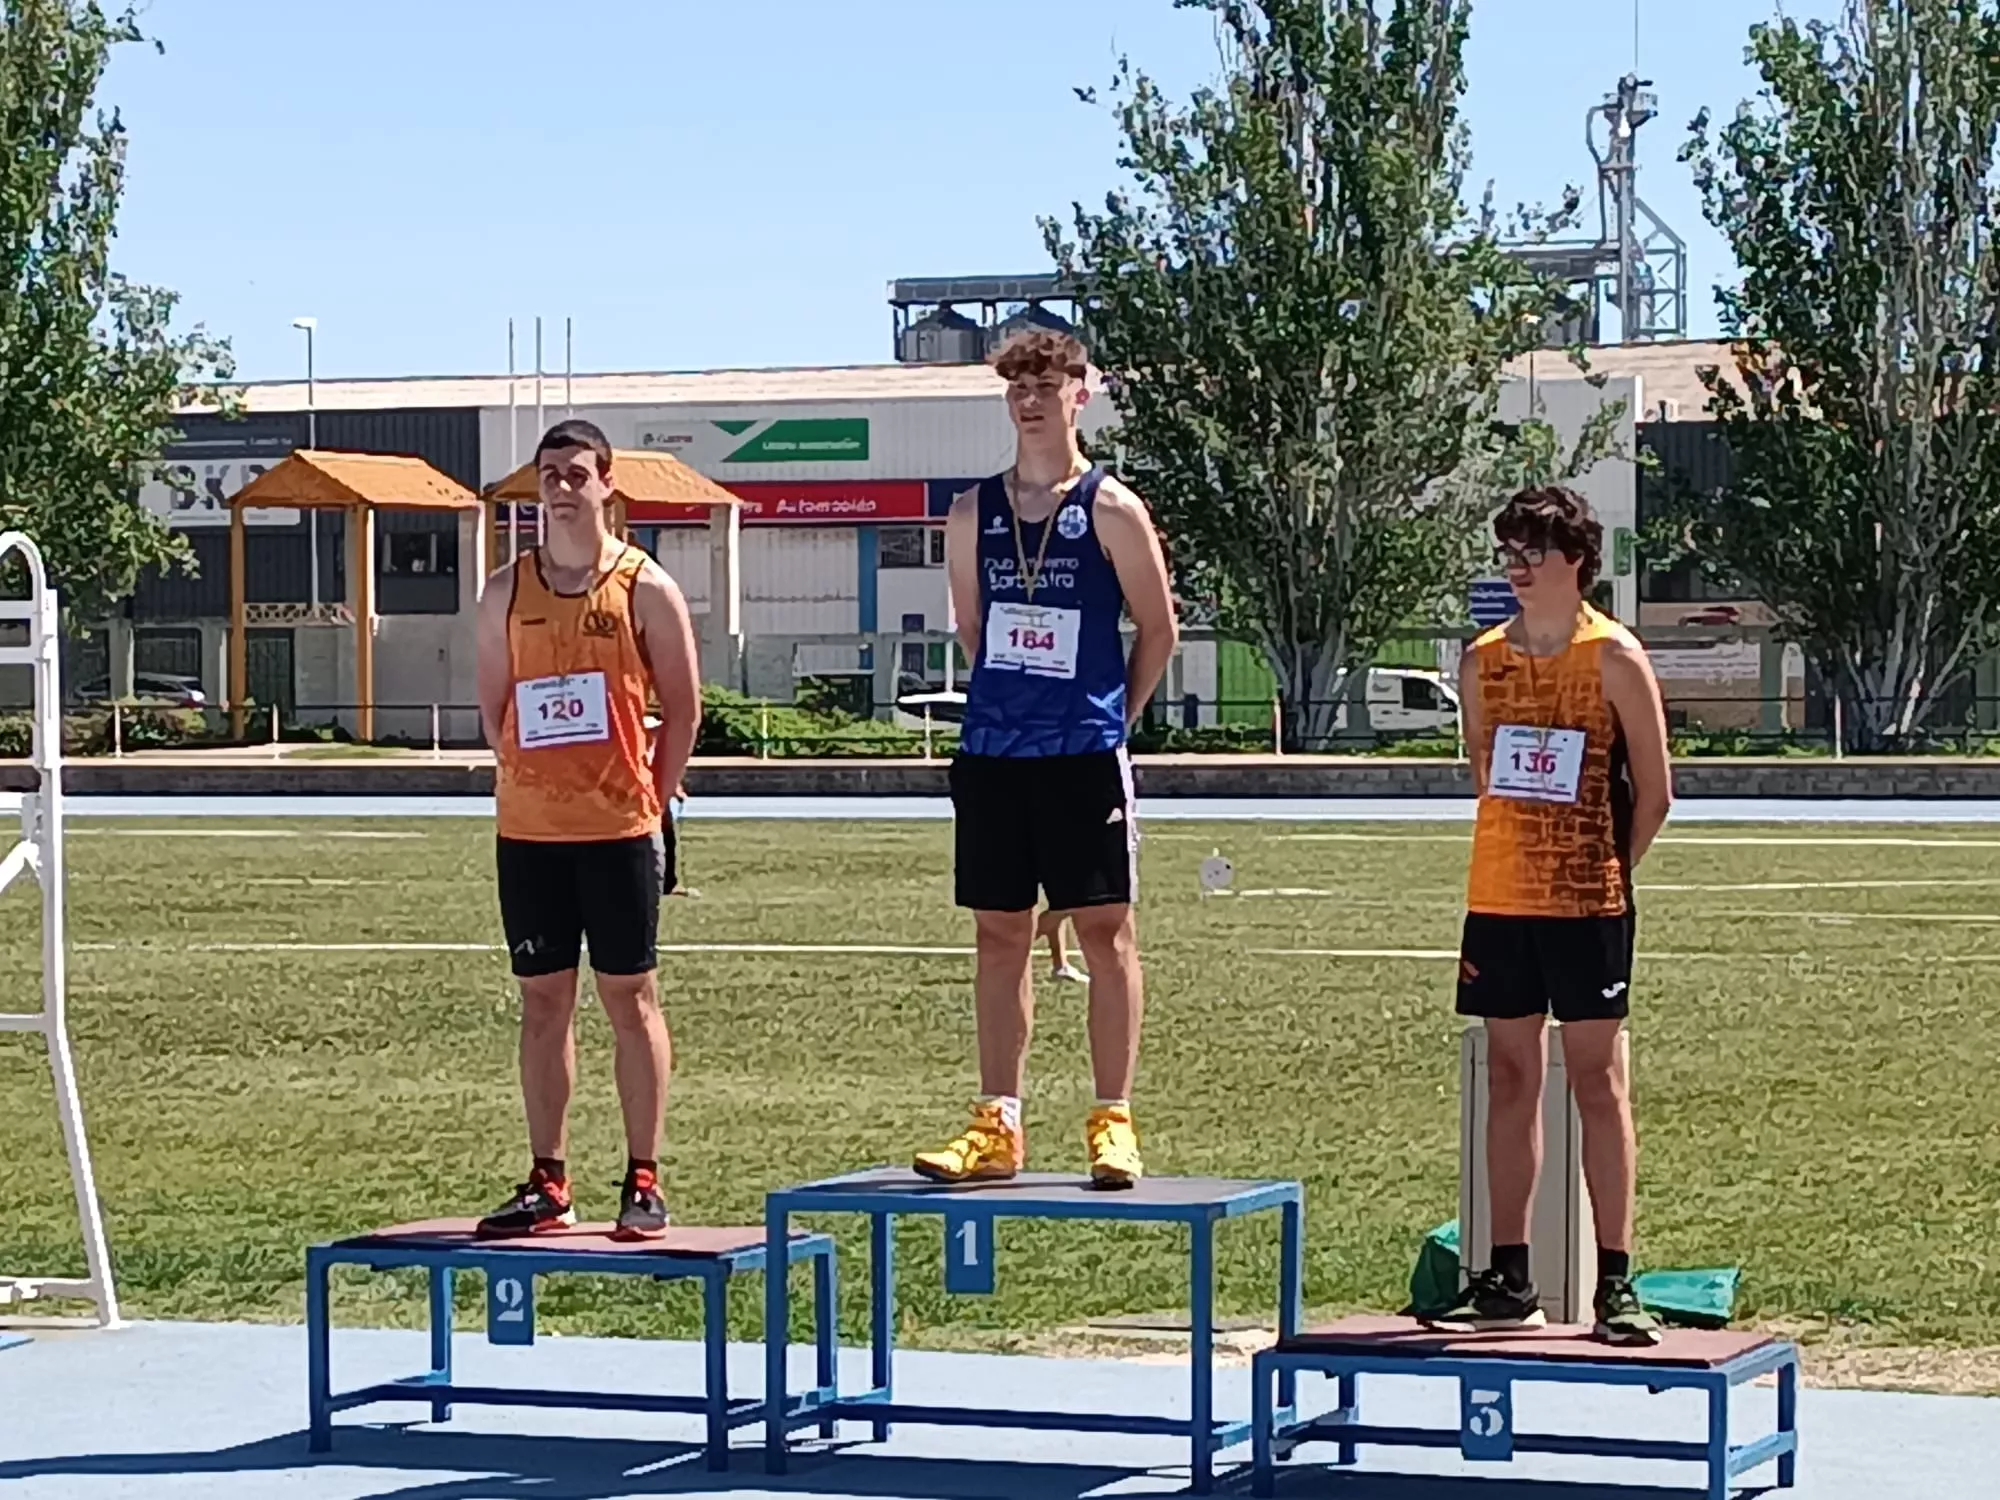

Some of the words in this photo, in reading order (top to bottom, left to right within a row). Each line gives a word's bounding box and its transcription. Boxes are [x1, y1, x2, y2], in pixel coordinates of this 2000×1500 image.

[1008, 627, 1055, 651] 184
[538, 698, 584, 721] 120
[1510, 751, 1557, 774] 136
[955, 1220, 978, 1266] 1
[495, 1278, 524, 1322] 2
